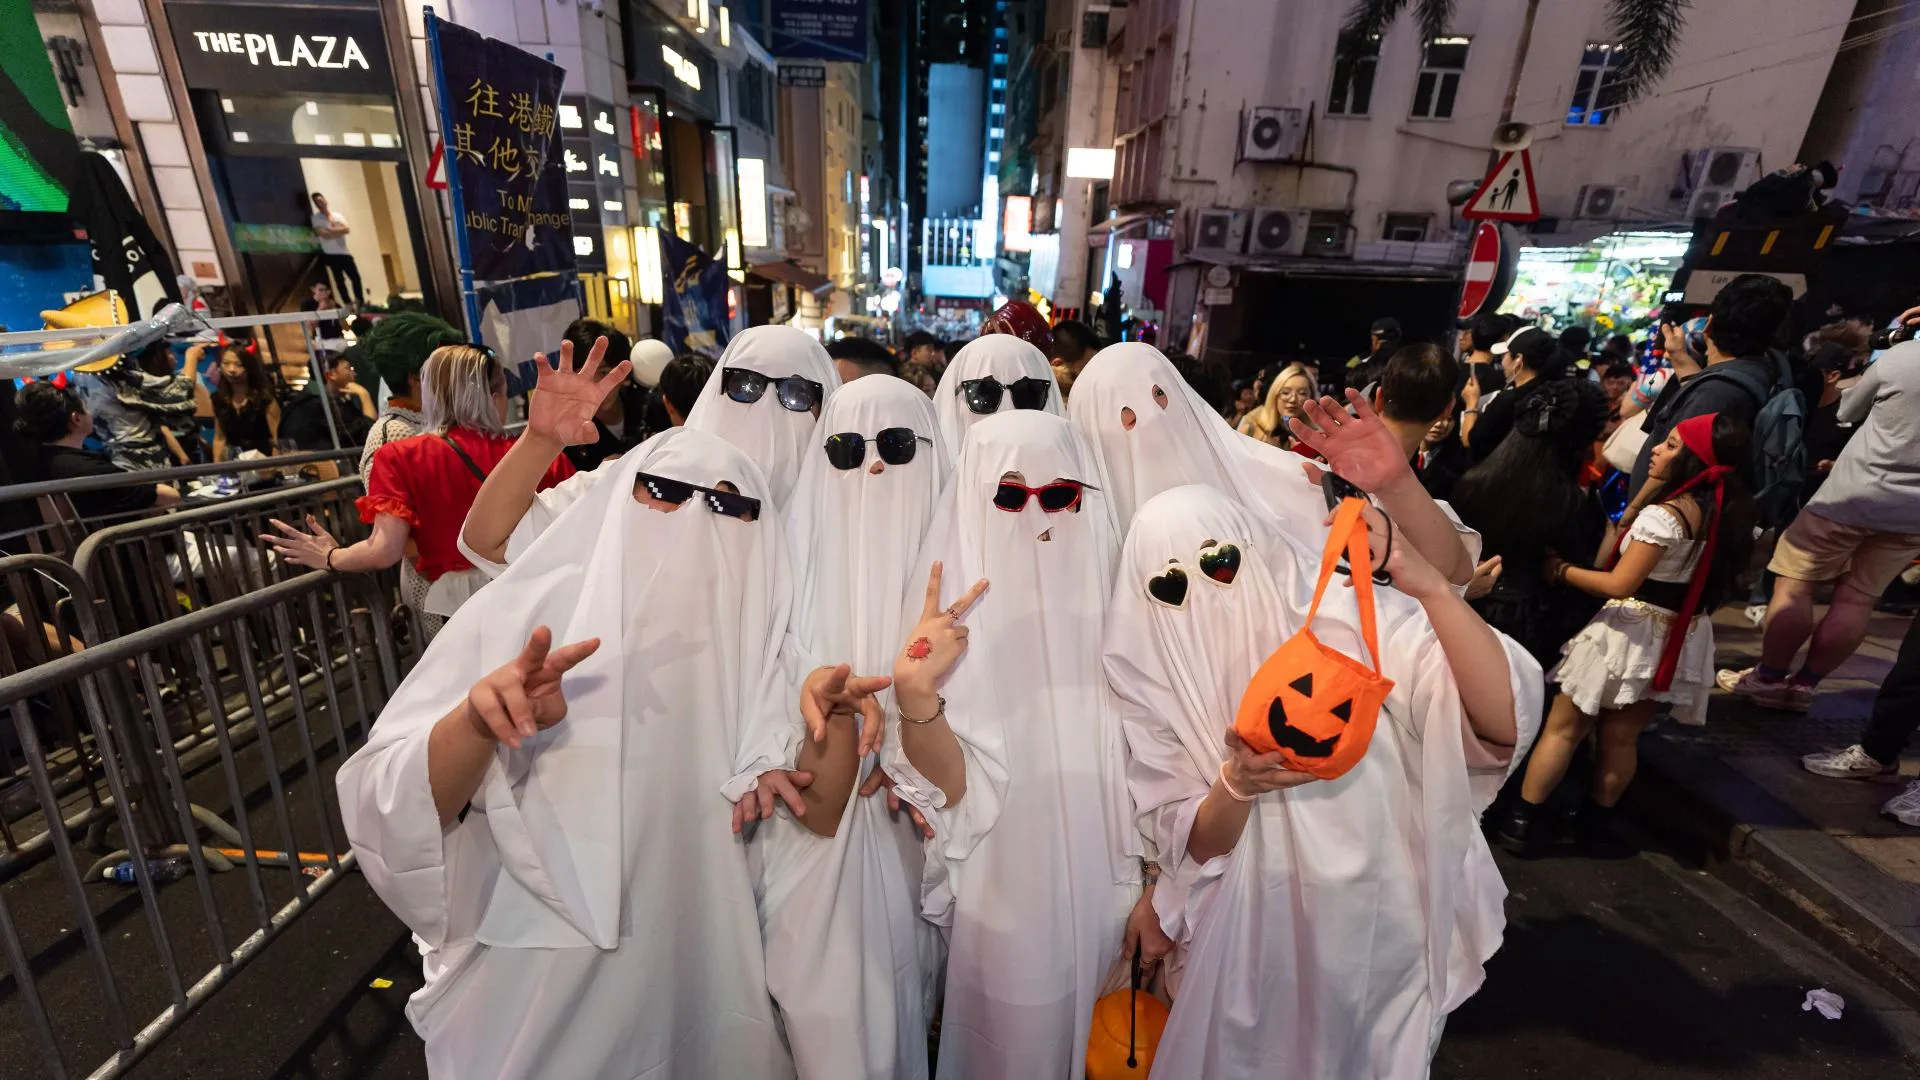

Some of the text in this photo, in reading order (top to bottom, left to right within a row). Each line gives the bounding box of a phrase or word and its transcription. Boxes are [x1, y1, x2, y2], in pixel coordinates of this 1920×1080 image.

[193, 31, 370, 70] THE PLAZA
[465, 78, 554, 141] 往港鐵
[453, 122, 541, 181] 其他交
[496, 189, 515, 210] To
[464, 210, 498, 232] ublic
